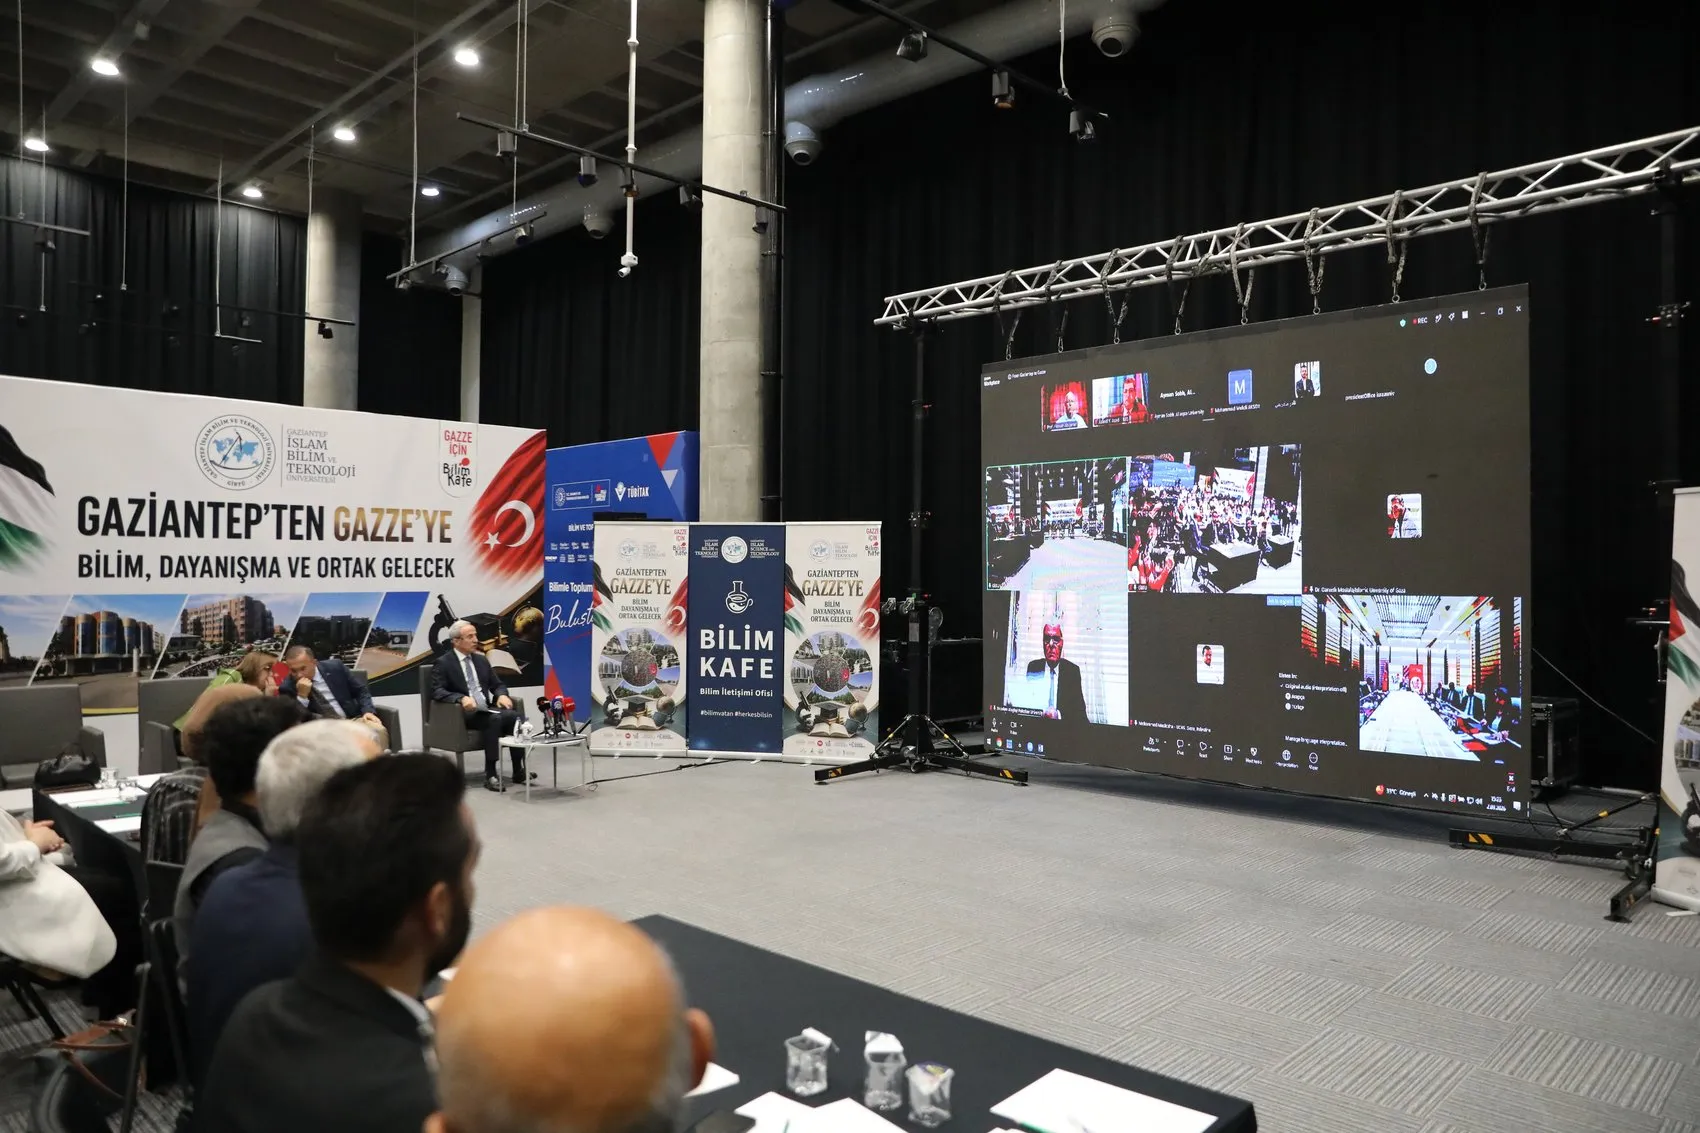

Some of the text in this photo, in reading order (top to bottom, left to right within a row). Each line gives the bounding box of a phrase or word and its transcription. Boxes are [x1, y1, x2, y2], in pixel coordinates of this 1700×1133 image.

[1418, 316, 1428, 324] REC
[1234, 379, 1246, 395] M
[287, 435, 328, 450] İSLAM
[444, 430, 472, 443] GAZZE
[287, 449, 325, 463] BİLİM
[449, 442, 467, 457] İÇİN
[286, 462, 356, 477] TEKNOLOJİ
[443, 462, 470, 475] Bilim
[448, 473, 472, 487] Kafe
[627, 485, 650, 498] TÜBİTAK
[77, 491, 453, 544] GAZİANTEP'TEN GAZZE'YE
[78, 549, 455, 584] BİLİM, DAYANIŞMA VE ORTAK GELECEK
[615, 567, 667, 576] GAZİANTEP'TEN
[807, 568, 859, 578] GAZİANTEP'TEN
[610, 578, 672, 595] GAZZE'YE
[802, 580, 864, 597] GAZZE'YE
[700, 623, 774, 651] BİLİM
[700, 656, 774, 679] KAFE
[700, 687, 773, 698] Bilim İletişimi Ofisi
[700, 709, 734, 717] #bilimvatan
